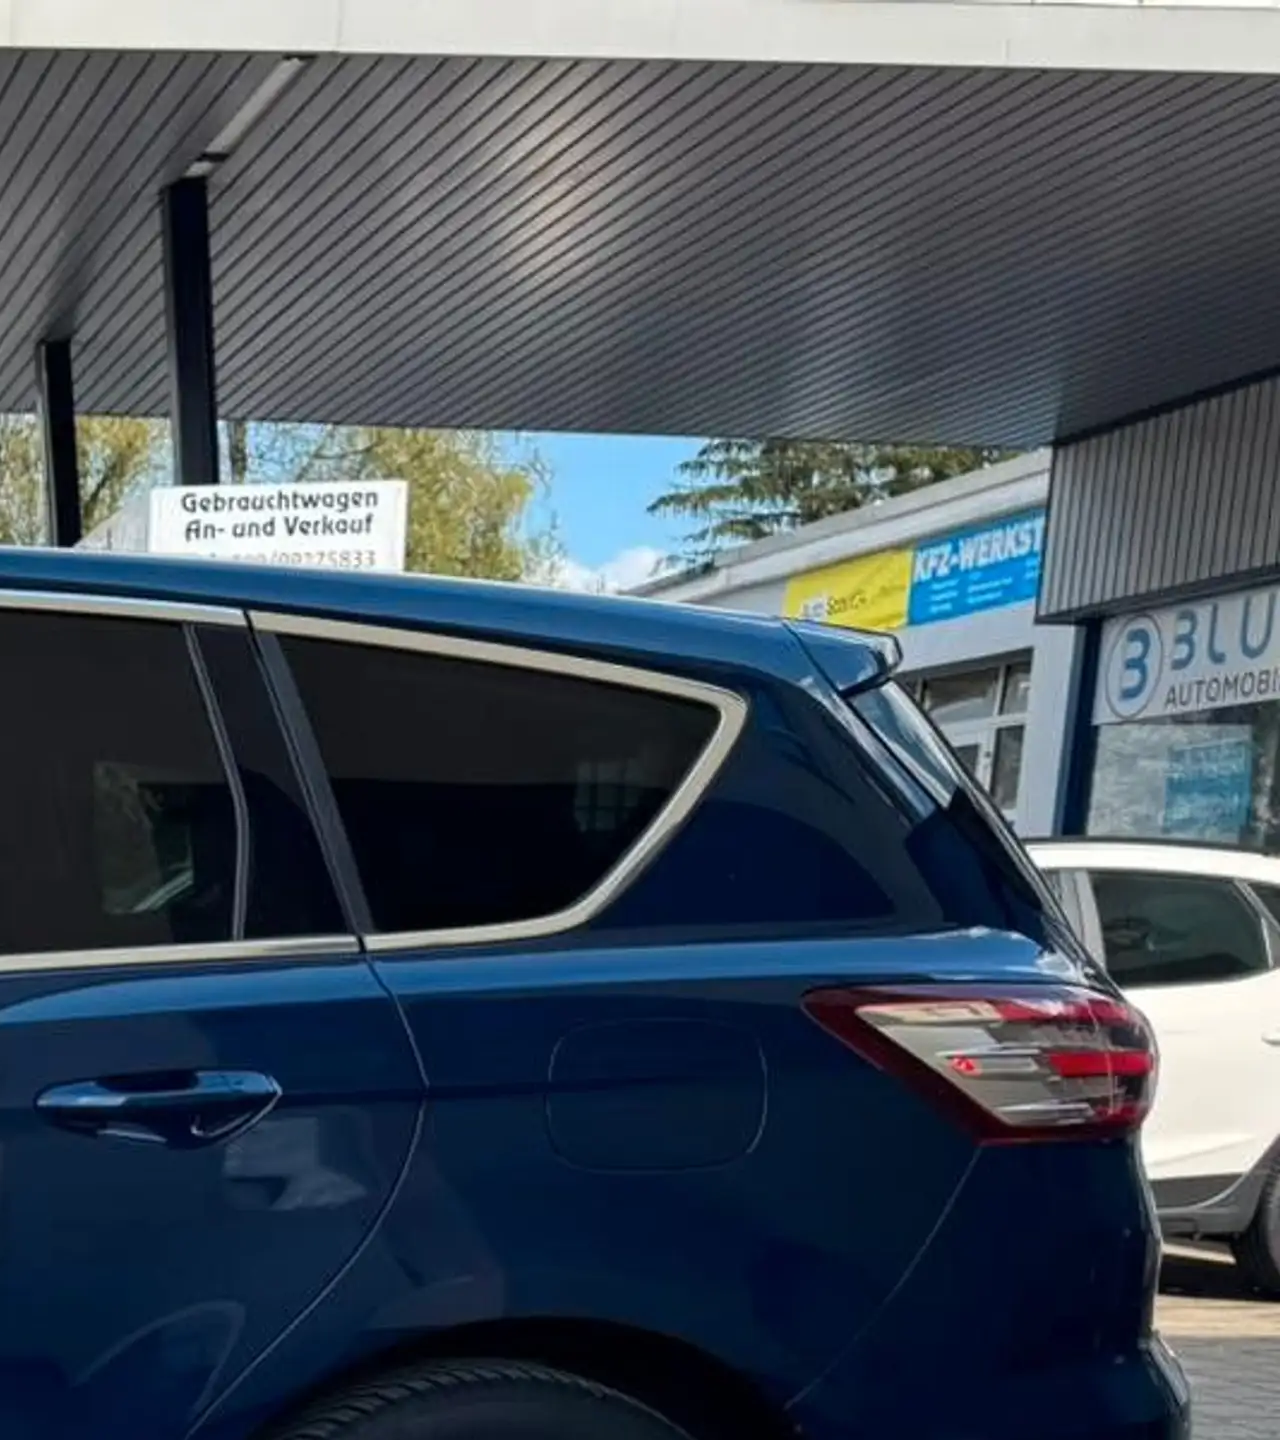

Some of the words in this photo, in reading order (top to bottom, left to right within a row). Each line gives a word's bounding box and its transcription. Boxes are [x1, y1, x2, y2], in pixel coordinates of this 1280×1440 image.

[181, 490, 378, 513] Gebrauchtwagen
[185, 518, 224, 542] An-
[232, 517, 275, 538] und
[283, 513, 374, 537] Verkauf
